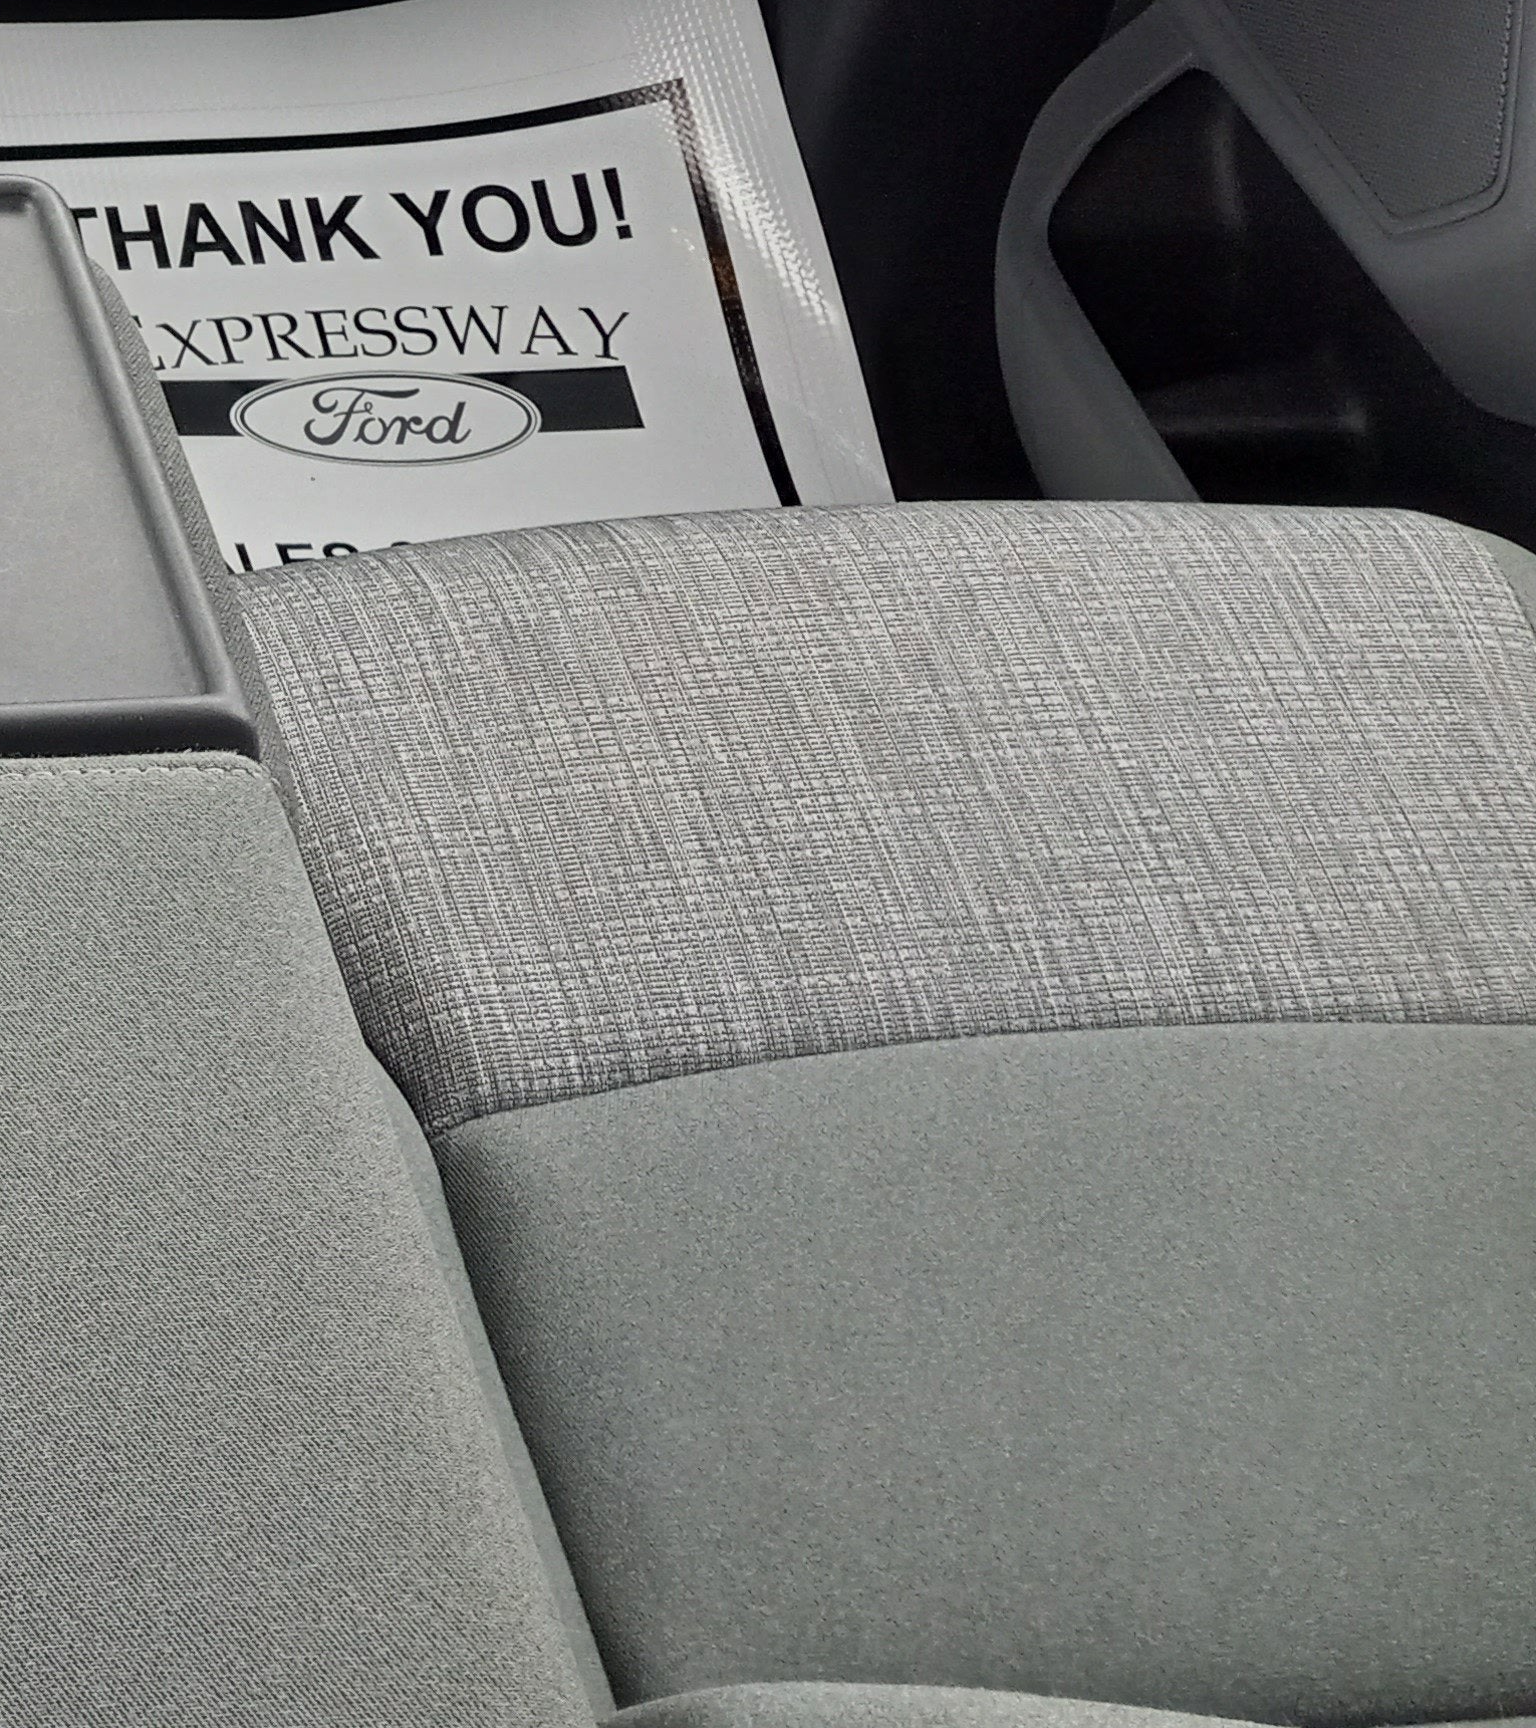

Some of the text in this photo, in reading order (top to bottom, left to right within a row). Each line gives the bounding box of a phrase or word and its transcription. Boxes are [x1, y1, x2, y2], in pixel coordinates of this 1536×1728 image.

[389, 167, 634, 257] YOU!
[130, 305, 631, 373] XPRESSWAY
[305, 387, 471, 447] Ford
